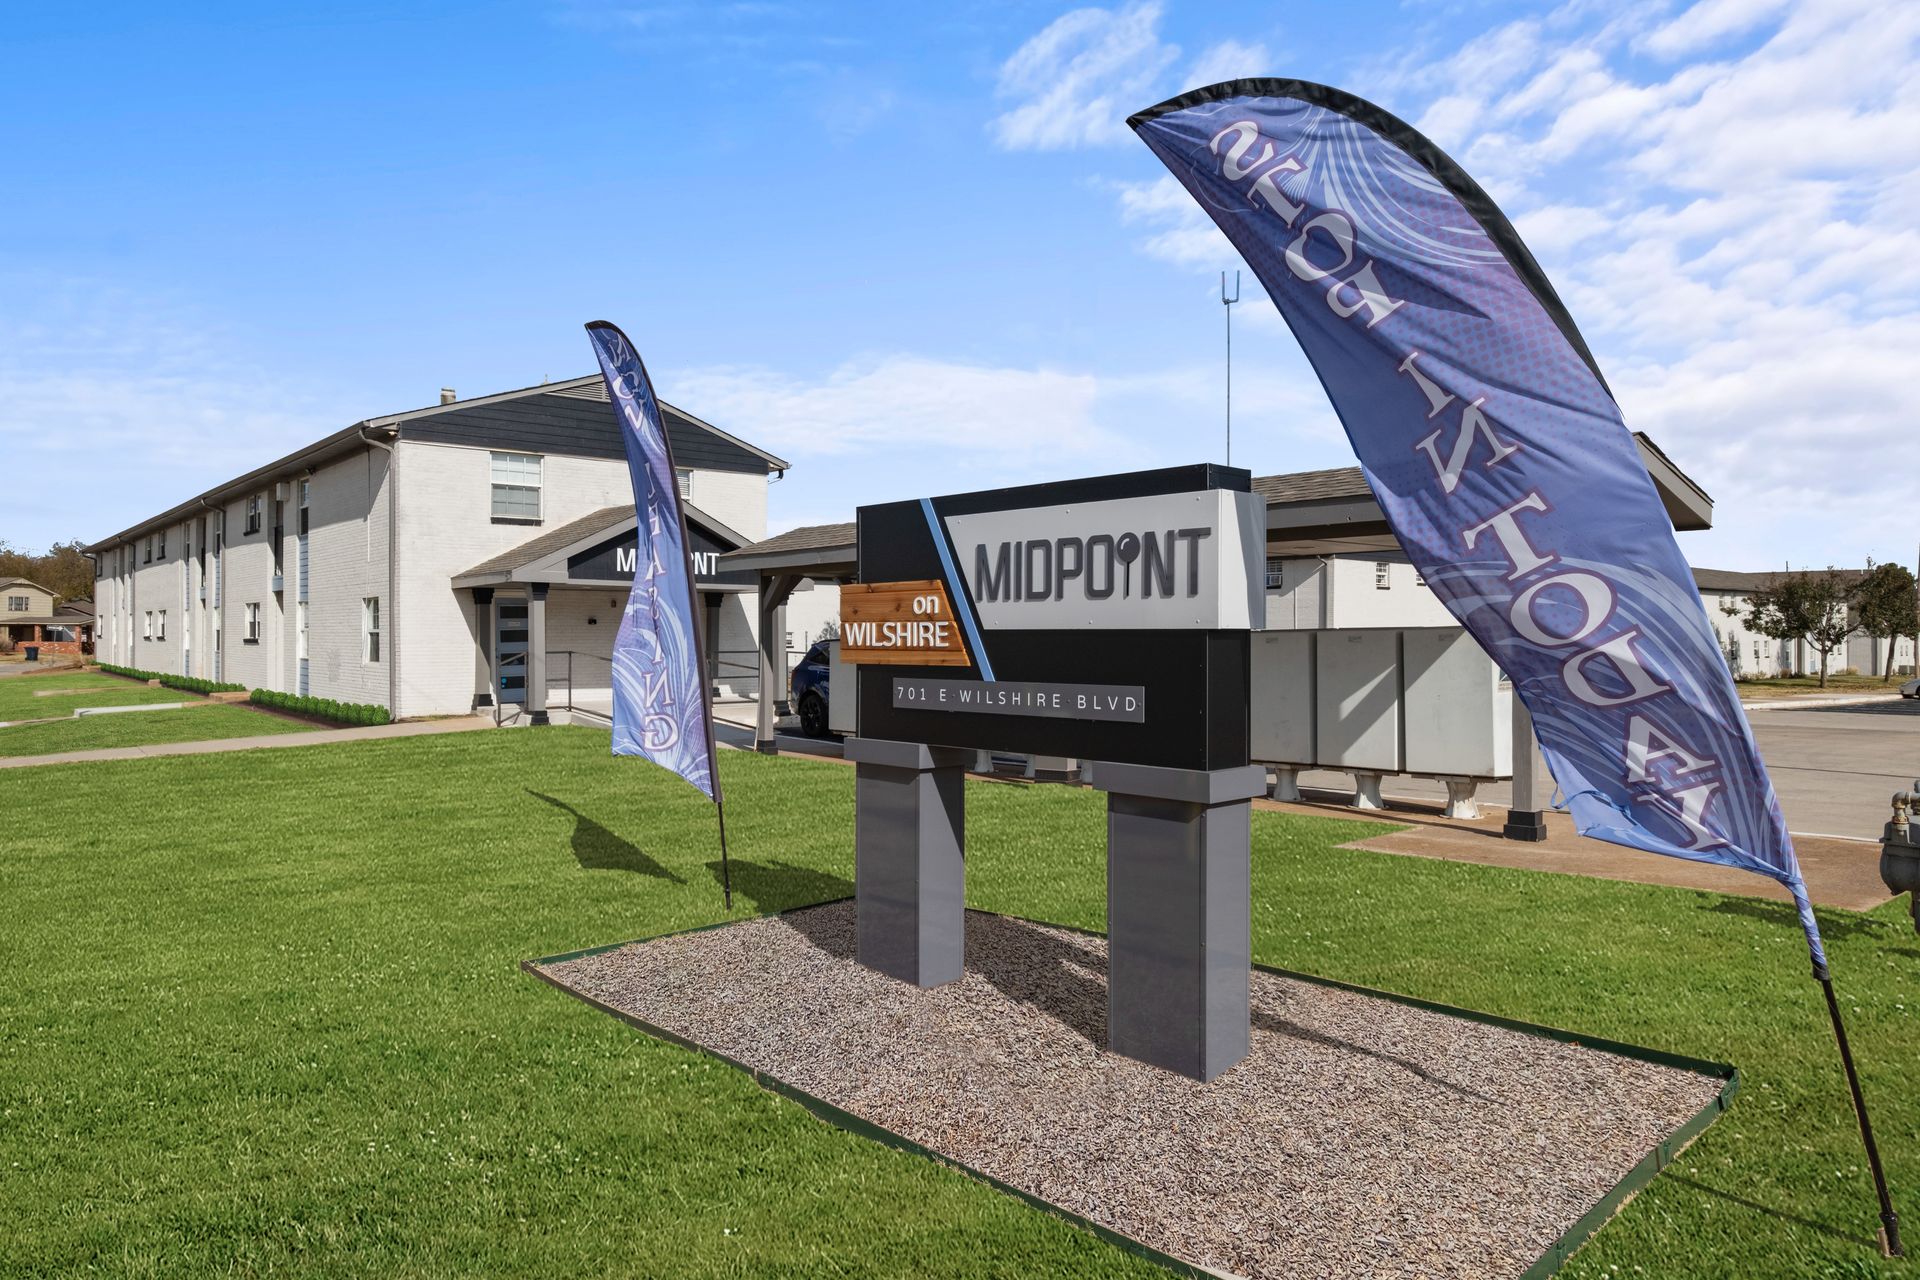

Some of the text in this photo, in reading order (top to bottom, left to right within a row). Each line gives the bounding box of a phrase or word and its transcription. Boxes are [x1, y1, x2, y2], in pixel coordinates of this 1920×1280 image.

[974, 527, 1212, 603] MIDPOINT
[912, 595, 939, 615] on
[844, 621, 949, 648] WILSHIRE
[897, 686, 1137, 712] 701 E WILSHIRE BLVD
